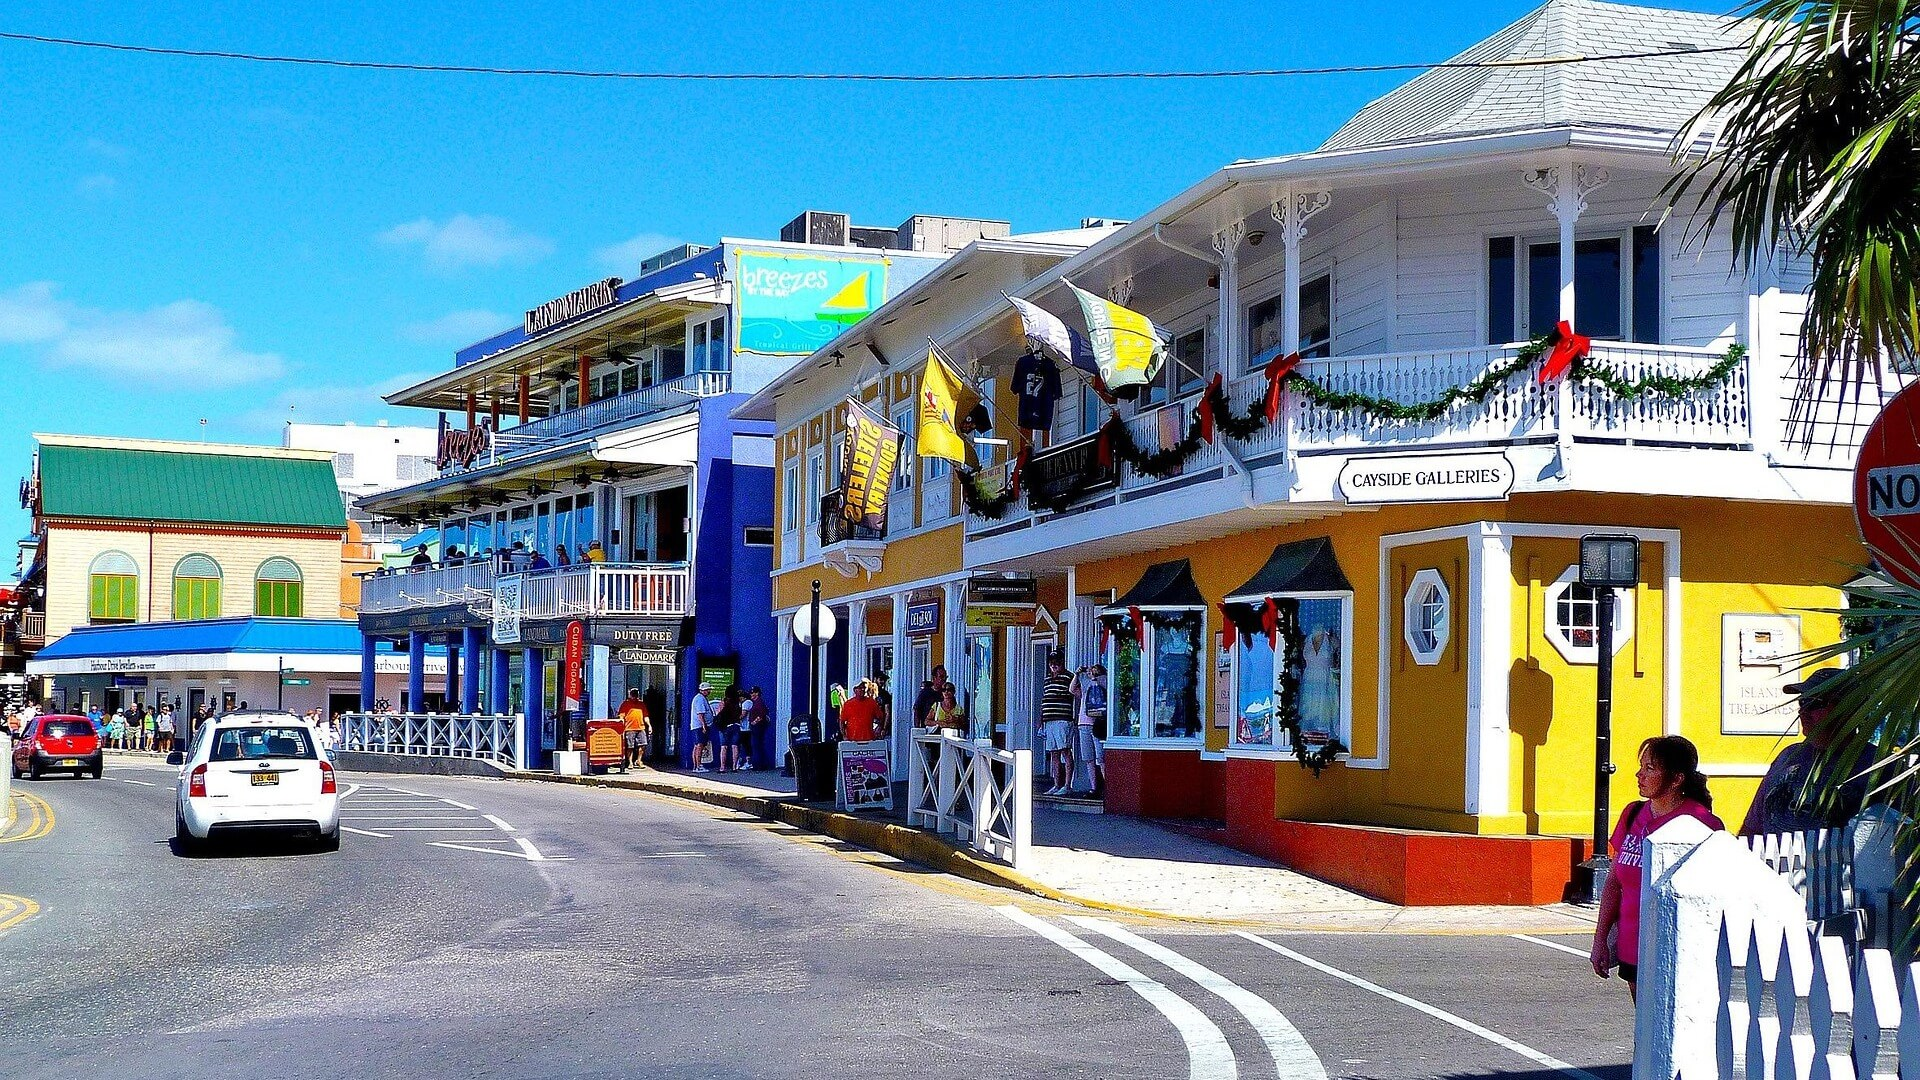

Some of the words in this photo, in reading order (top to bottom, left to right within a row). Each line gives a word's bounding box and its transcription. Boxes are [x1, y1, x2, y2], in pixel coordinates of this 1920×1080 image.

[743, 265, 828, 293] breezes
[1352, 472, 1411, 488] CAYSIDE
[1415, 469, 1500, 486] GALLERIES
[1869, 473, 1920, 511] NO
[571, 626, 580, 658] CUBAN
[614, 630, 643, 641] DUTY
[645, 630, 673, 641] FREE
[425, 663, 446, 671] rive
[625, 651, 676, 662] LANDMARK
[569, 662, 578, 695] CIGARS
